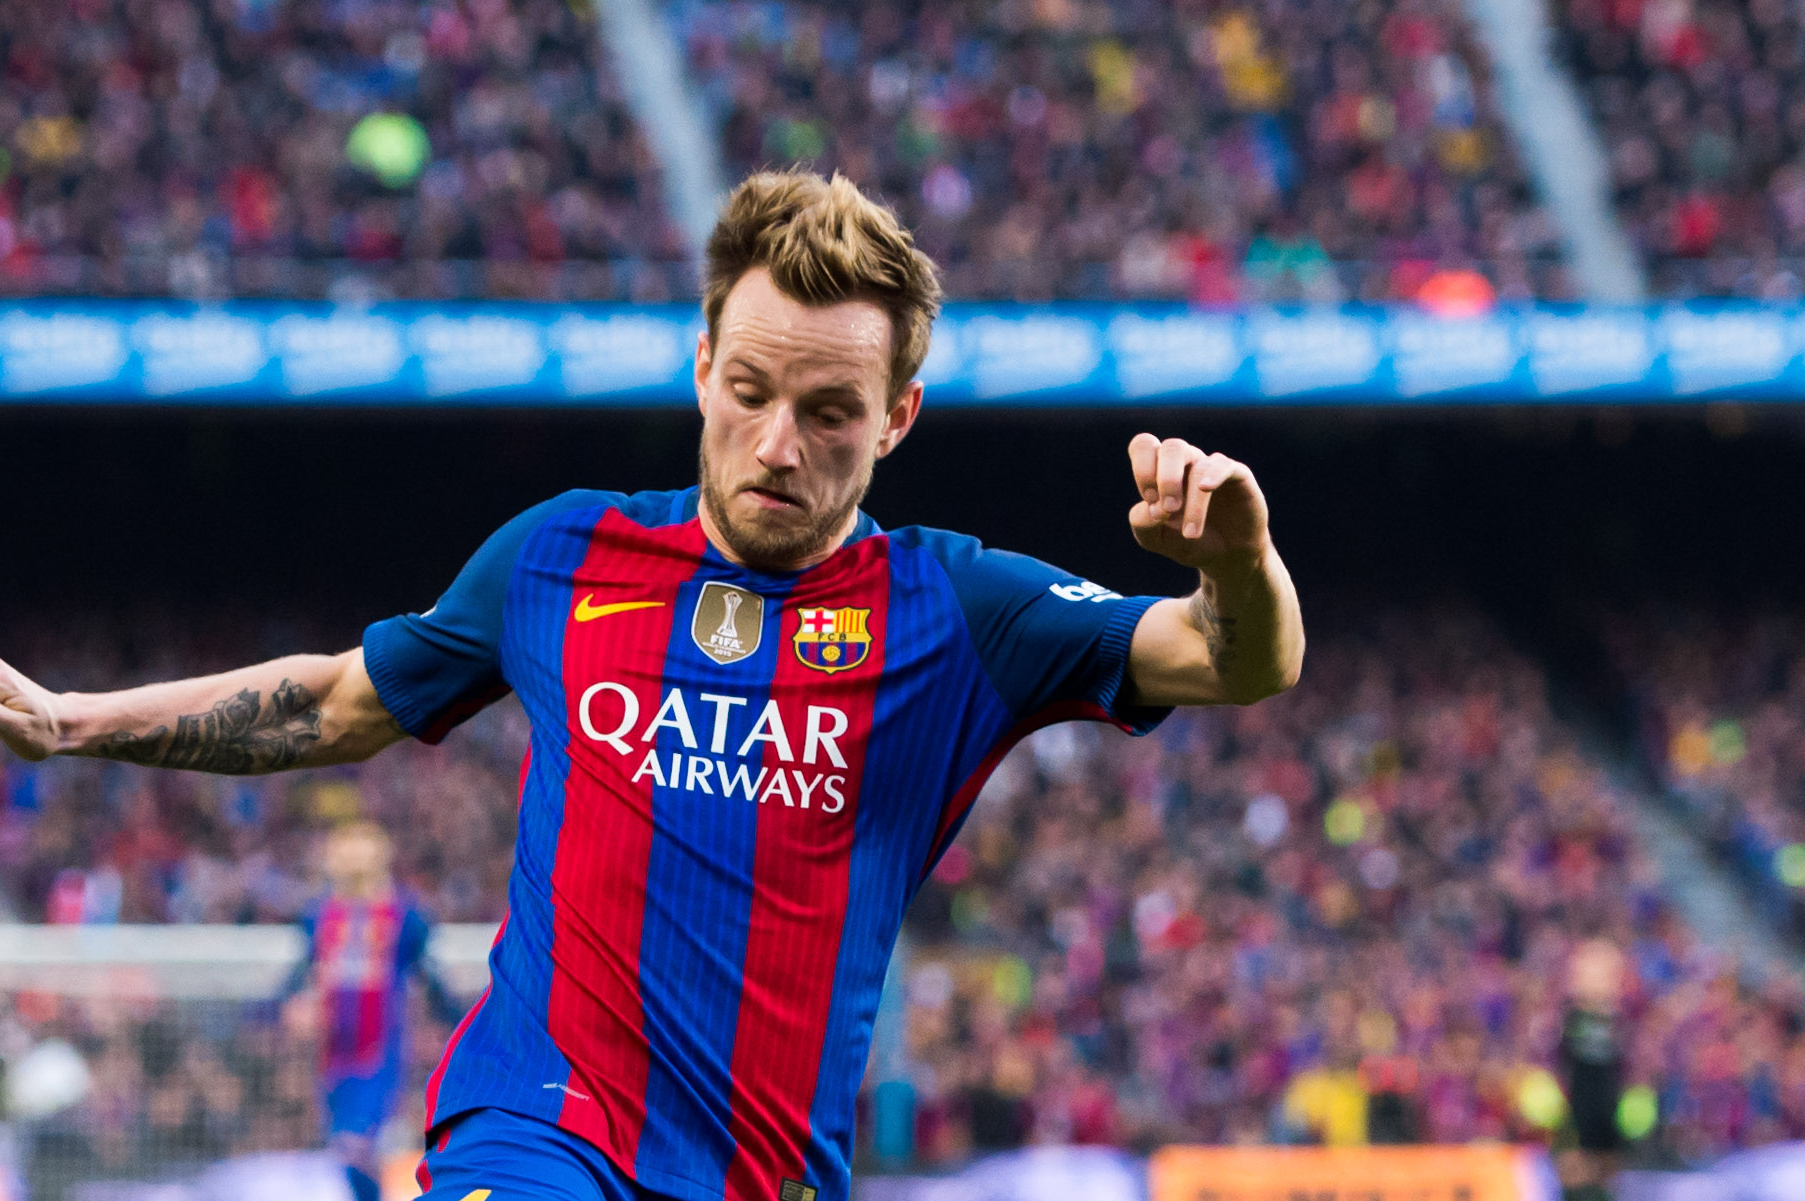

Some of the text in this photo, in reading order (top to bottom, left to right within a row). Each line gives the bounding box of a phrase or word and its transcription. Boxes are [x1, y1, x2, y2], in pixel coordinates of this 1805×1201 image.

[710, 634, 740, 650] FIFA
[578, 681, 849, 769] QATAR
[631, 749, 846, 814] AIRWAYS
